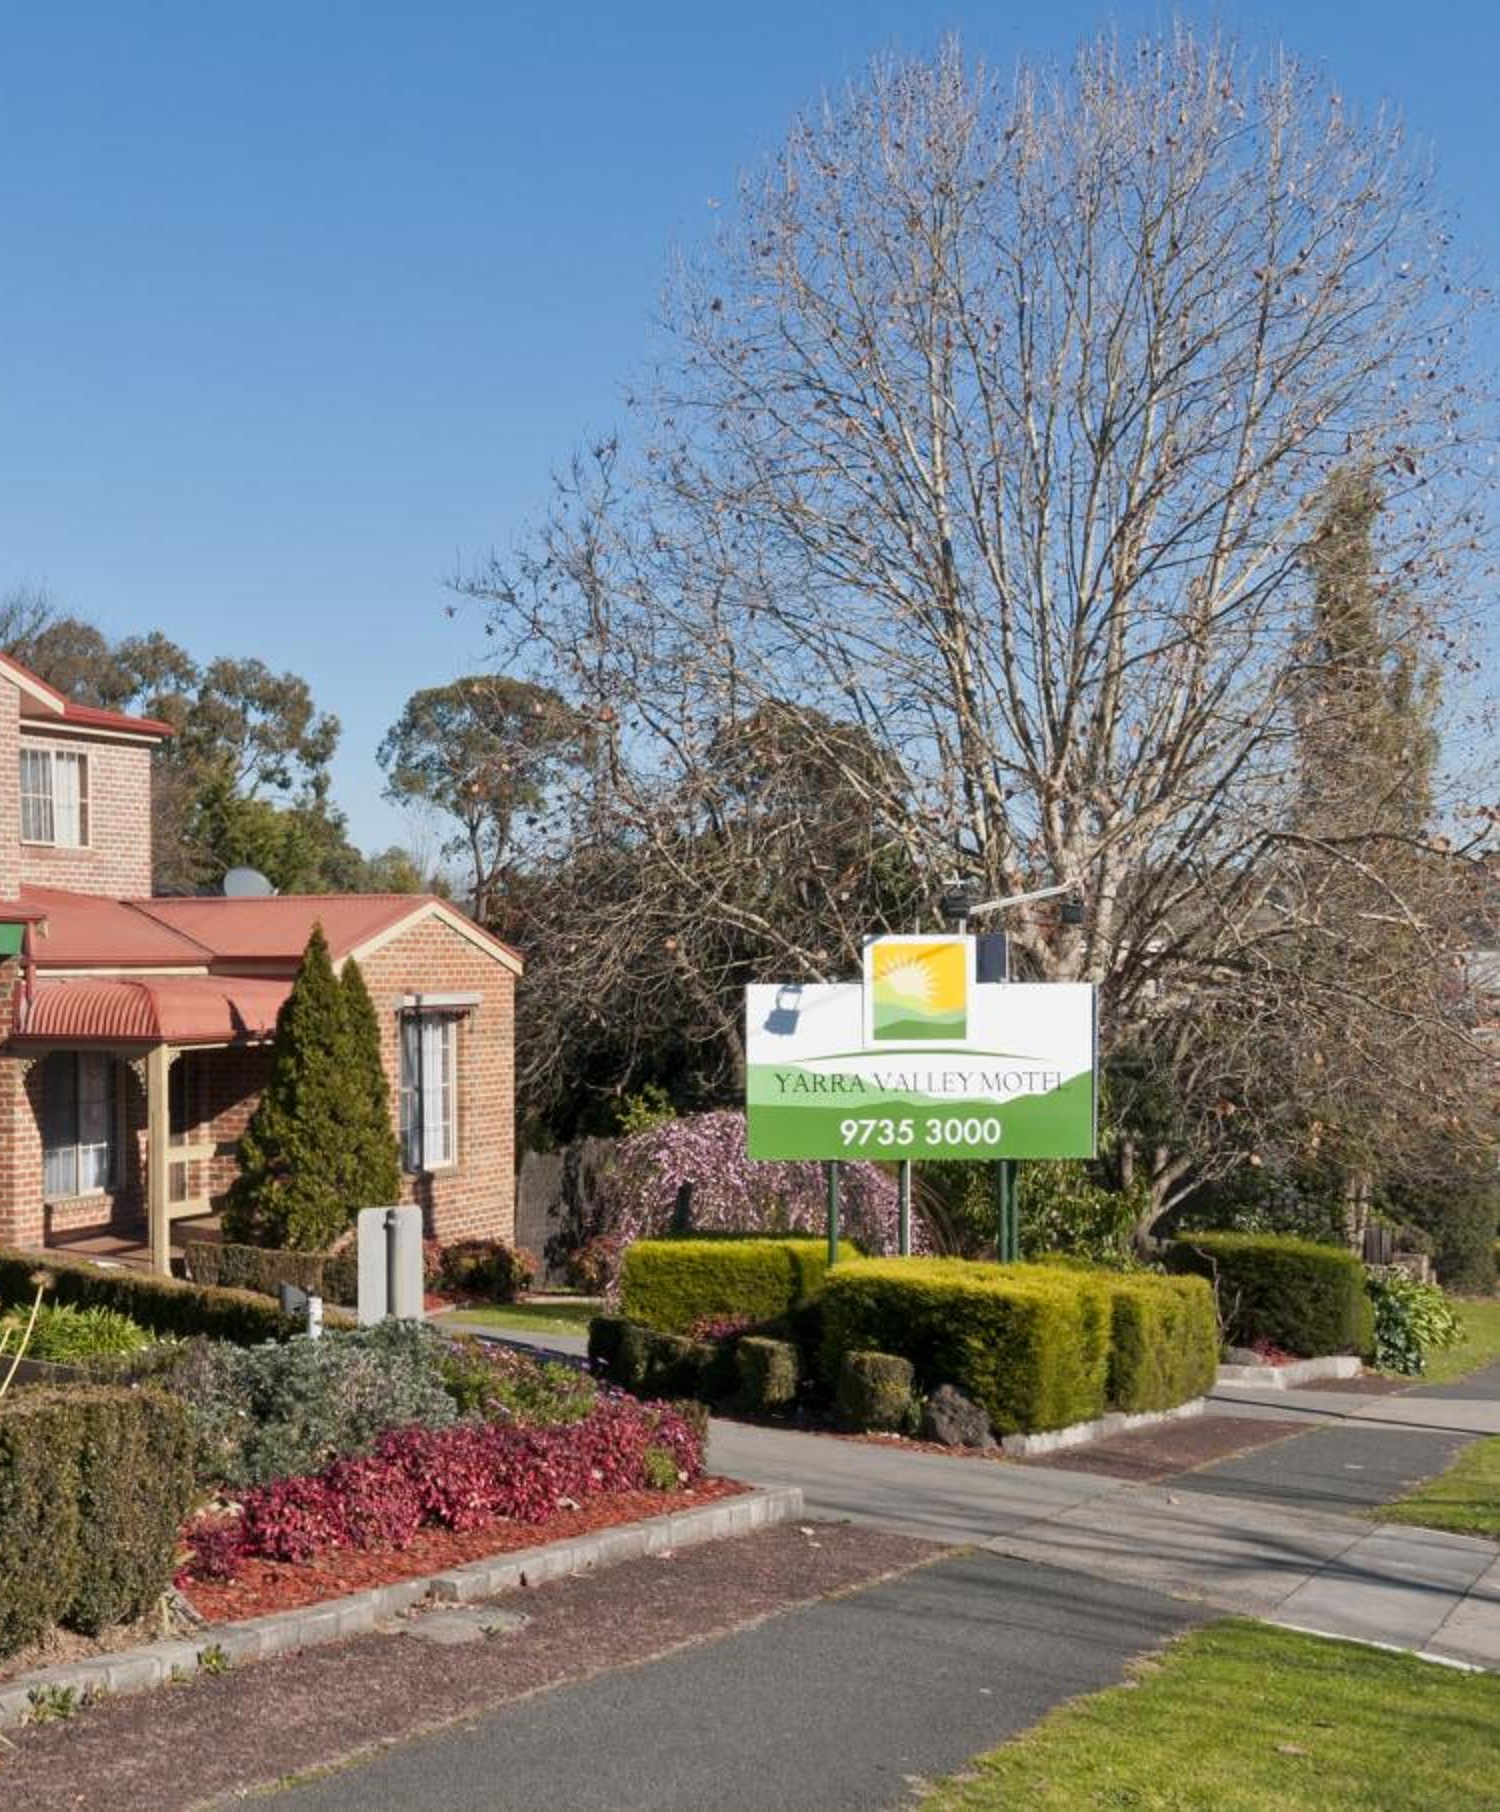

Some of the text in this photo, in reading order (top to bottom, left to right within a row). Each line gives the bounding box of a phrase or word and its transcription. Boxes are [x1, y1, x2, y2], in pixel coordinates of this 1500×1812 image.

[774, 1071, 1068, 1093] YARRA VALLEY MOTEL
[840, 1118, 1001, 1146] 9735 3000
